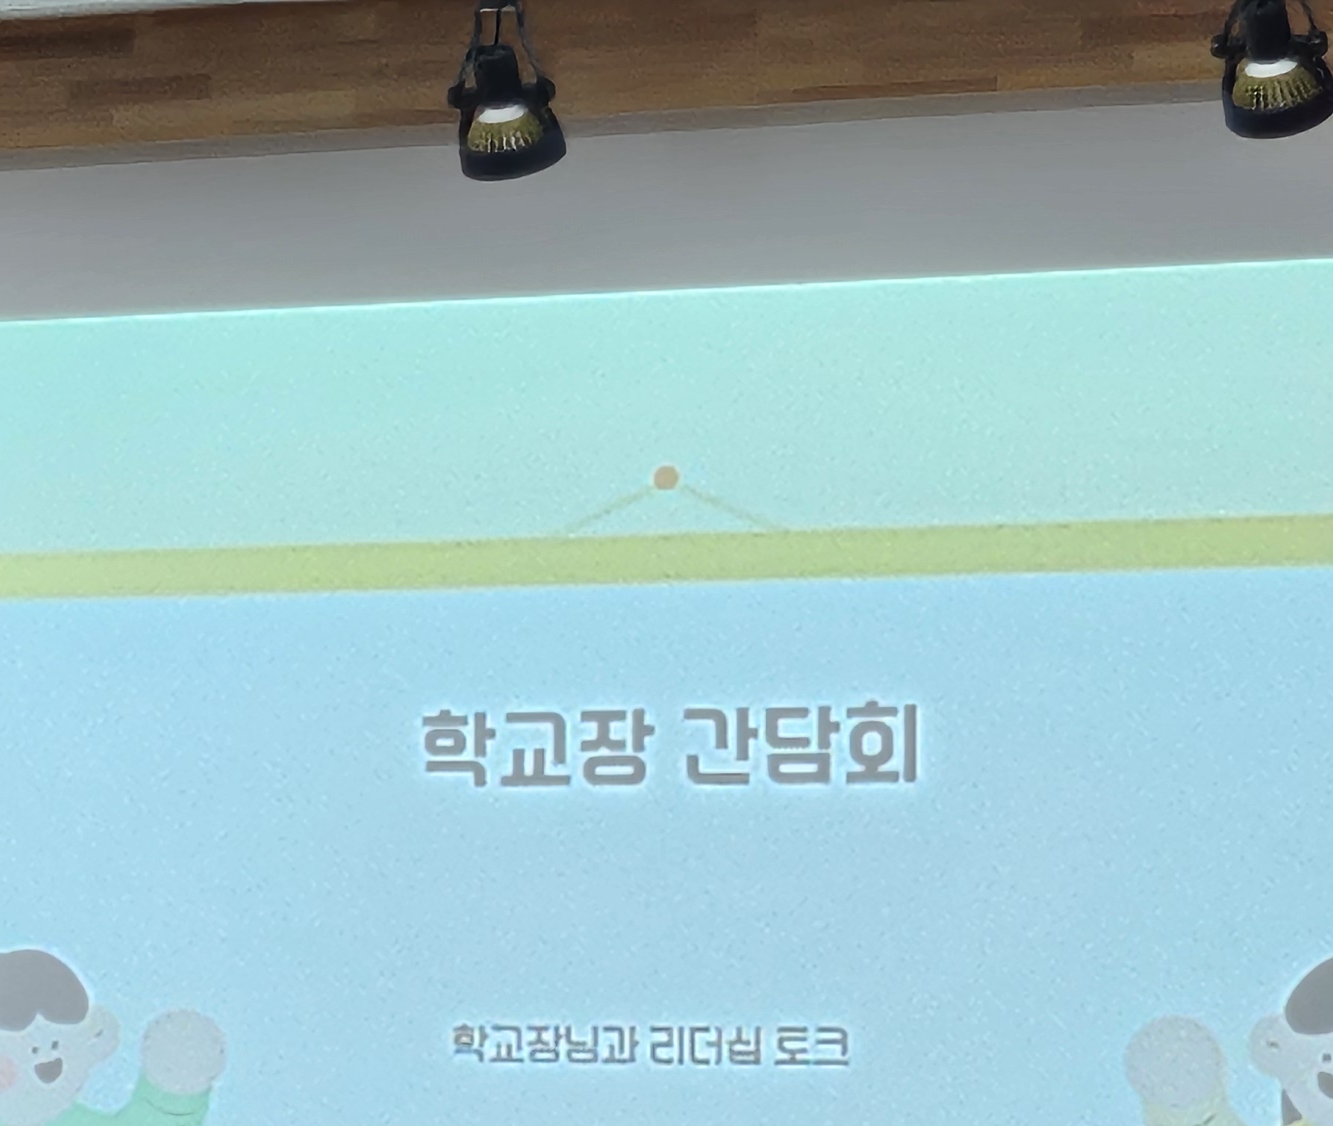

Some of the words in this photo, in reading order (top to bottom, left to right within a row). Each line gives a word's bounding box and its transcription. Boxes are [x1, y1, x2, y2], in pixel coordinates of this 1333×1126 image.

[422, 708, 655, 787] 학교장
[683, 700, 918, 786] 간담회
[452, 1023, 638, 1064] 학교장님과
[649, 1025, 761, 1066] 리더십
[774, 1027, 850, 1067] 토크
